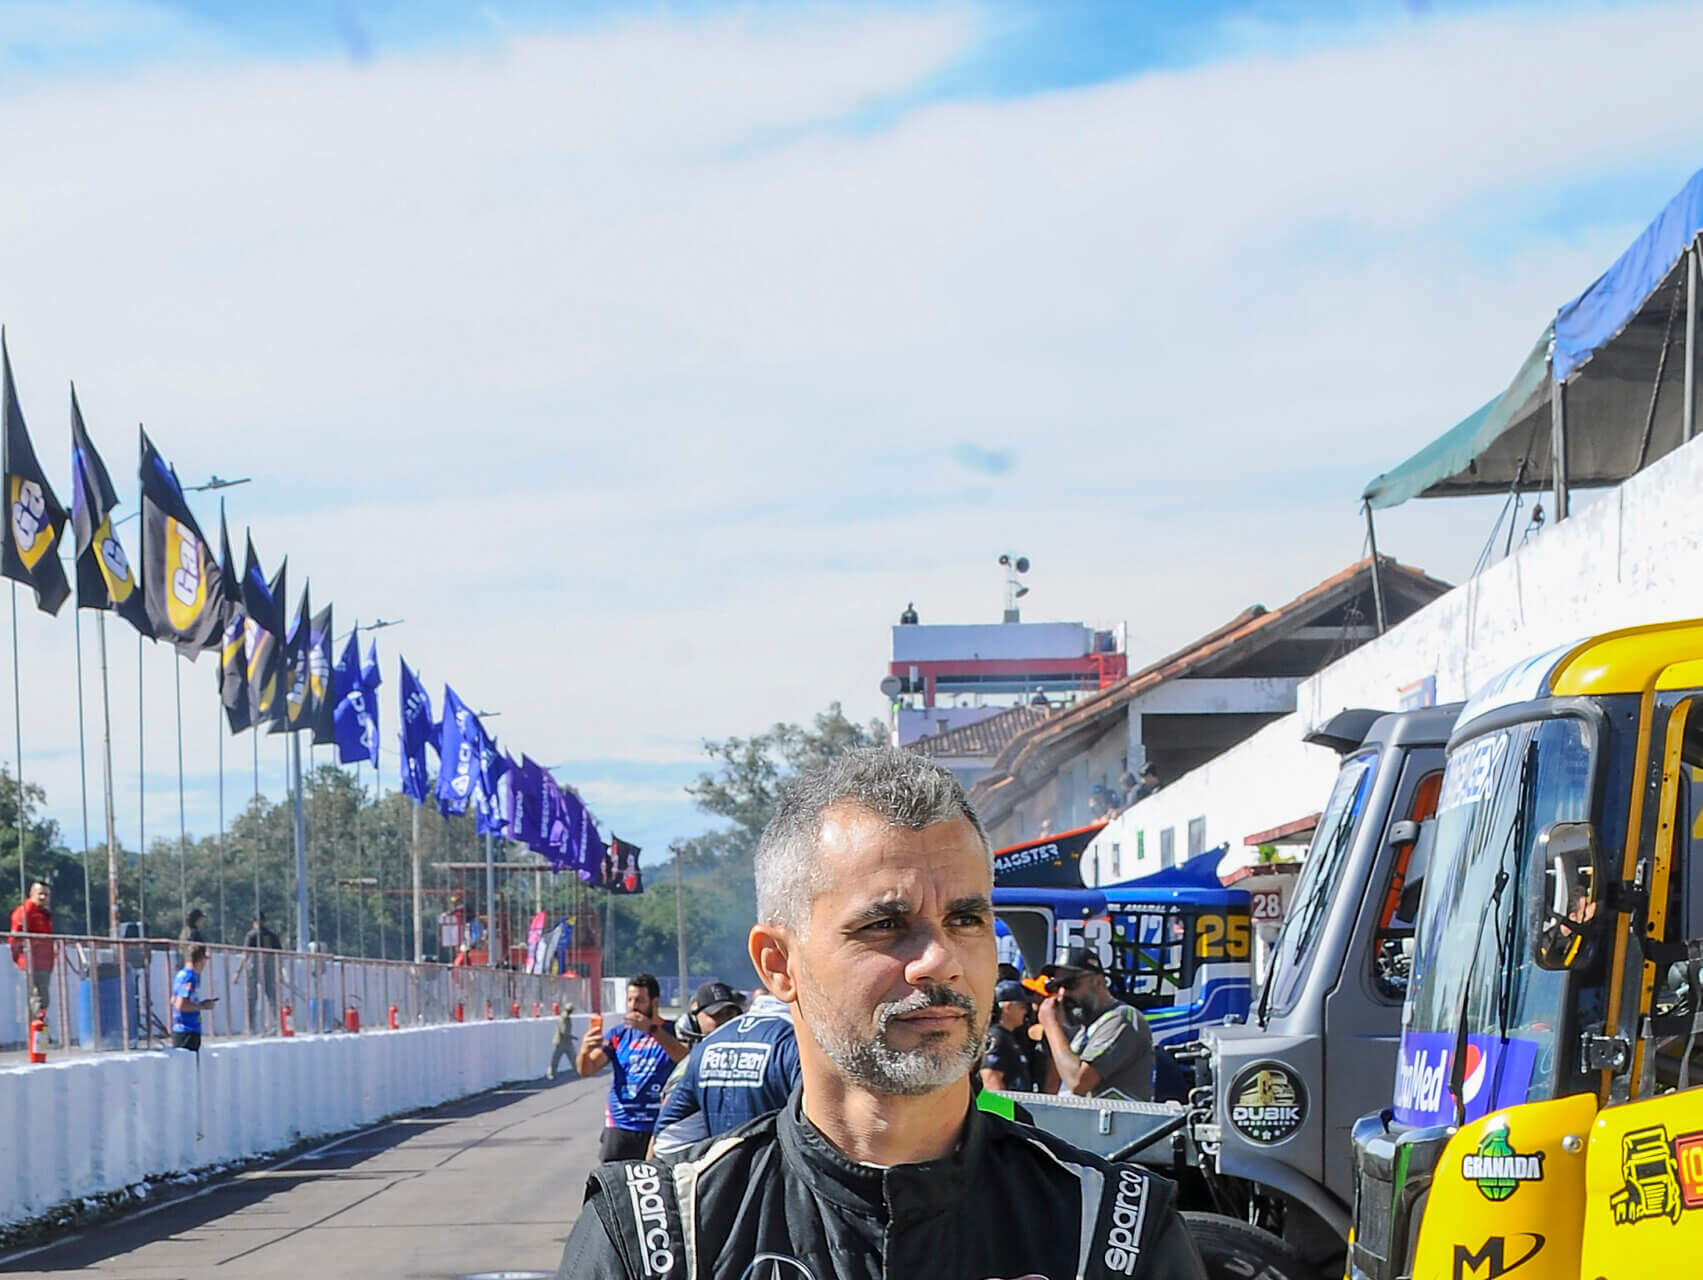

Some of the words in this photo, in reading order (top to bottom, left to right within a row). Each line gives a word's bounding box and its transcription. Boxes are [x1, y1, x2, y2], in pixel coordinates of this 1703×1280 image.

[1253, 893, 1281, 918] 28
[1195, 914, 1250, 958] 25
[1462, 1155, 1541, 1179] GRANADA
[625, 1164, 674, 1275] sparco
[1104, 1170, 1148, 1272] sparco
